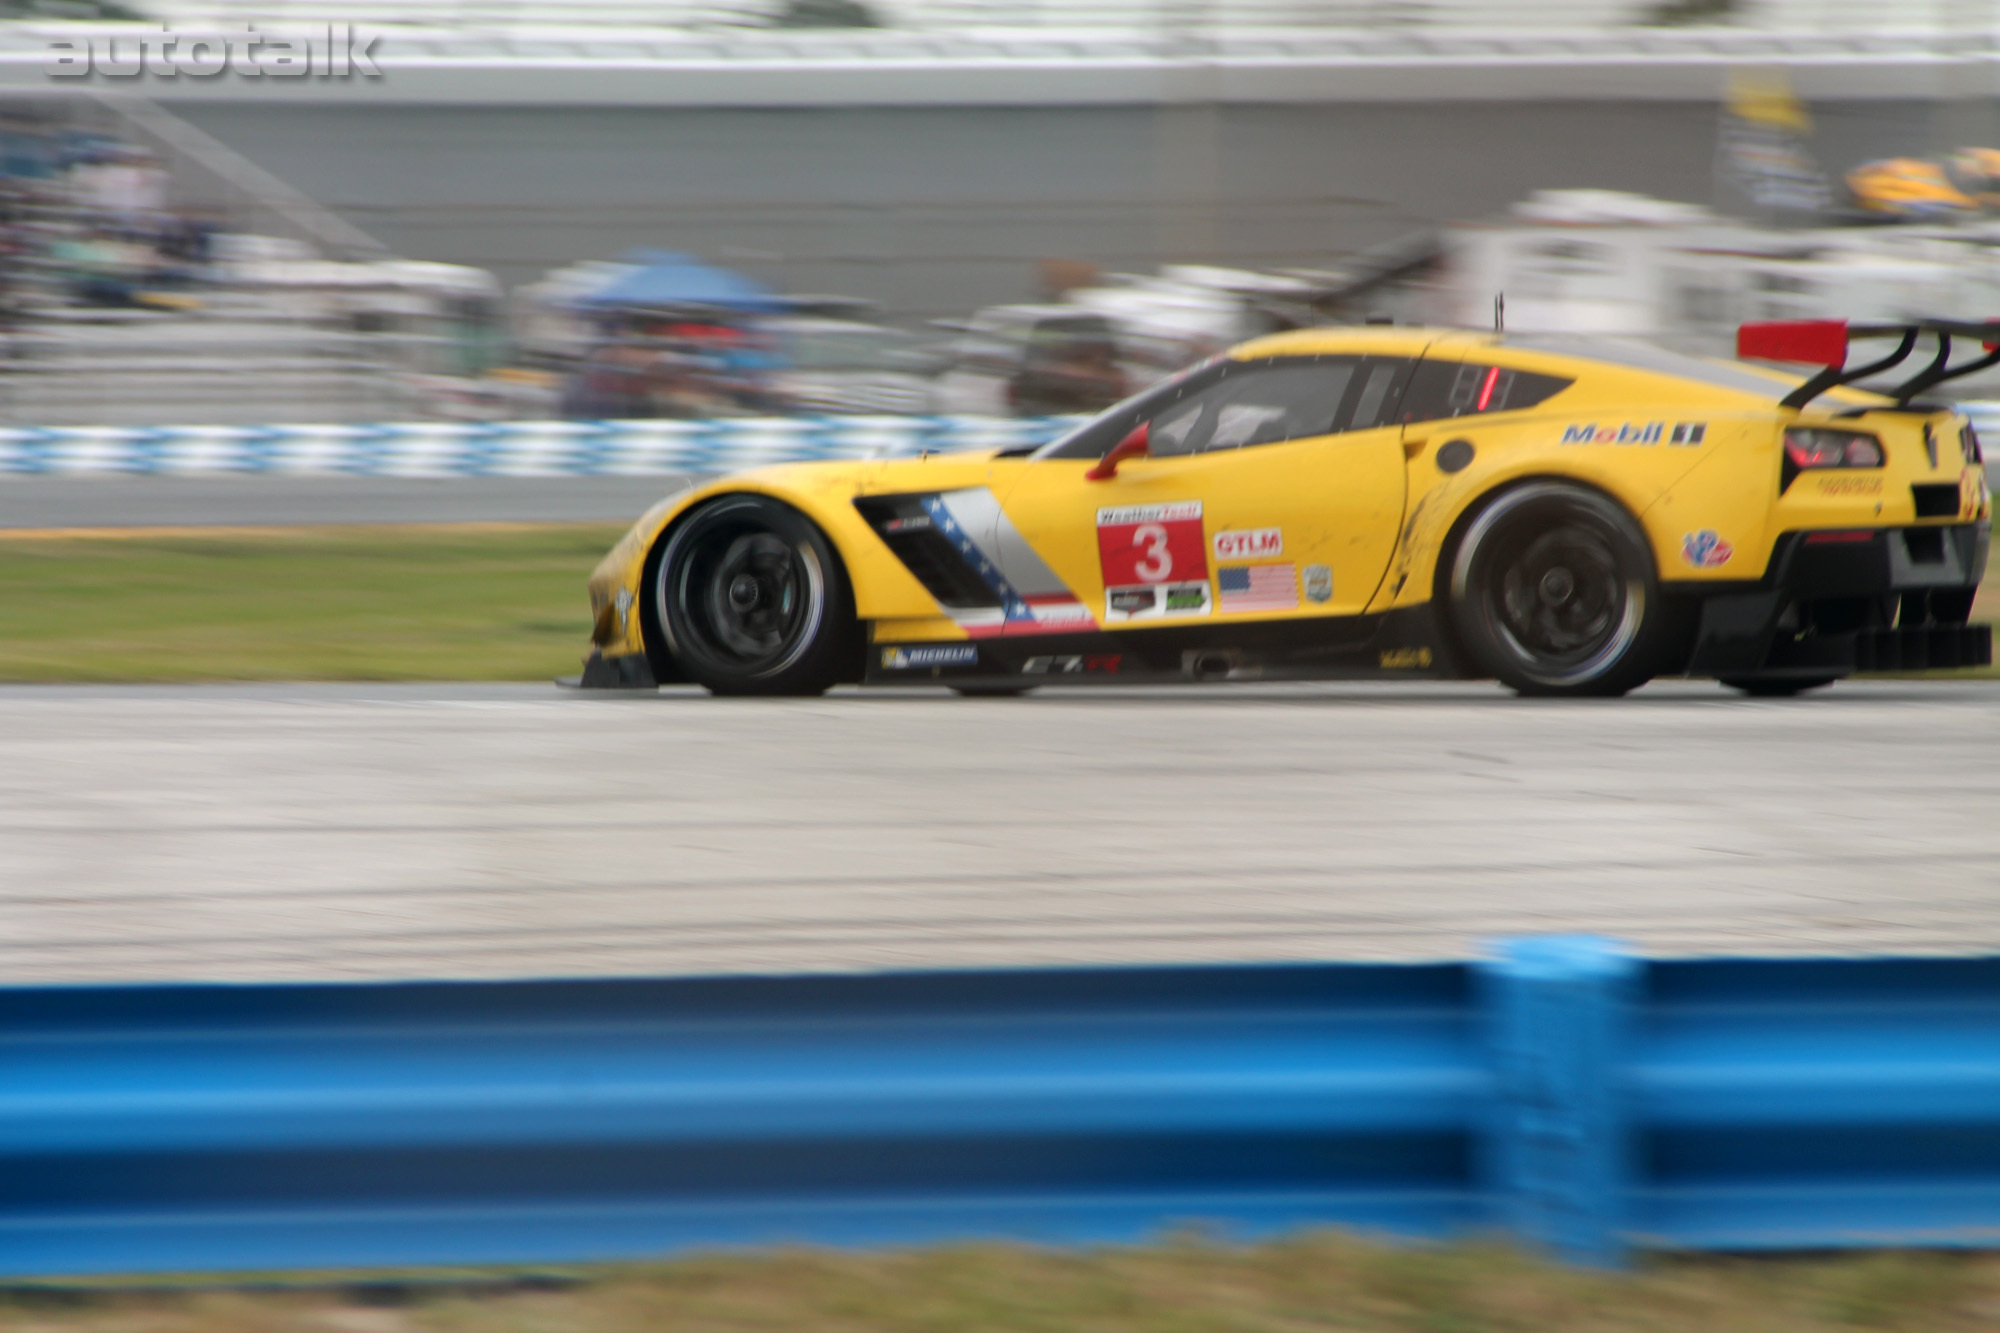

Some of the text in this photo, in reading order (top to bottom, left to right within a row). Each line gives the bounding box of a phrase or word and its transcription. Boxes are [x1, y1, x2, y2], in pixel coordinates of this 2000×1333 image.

[1561, 420, 1664, 446] Mobil
[1132, 523, 1173, 583] 3
[1217, 532, 1280, 554] GTLM
[909, 647, 975, 663] MICHELIN
